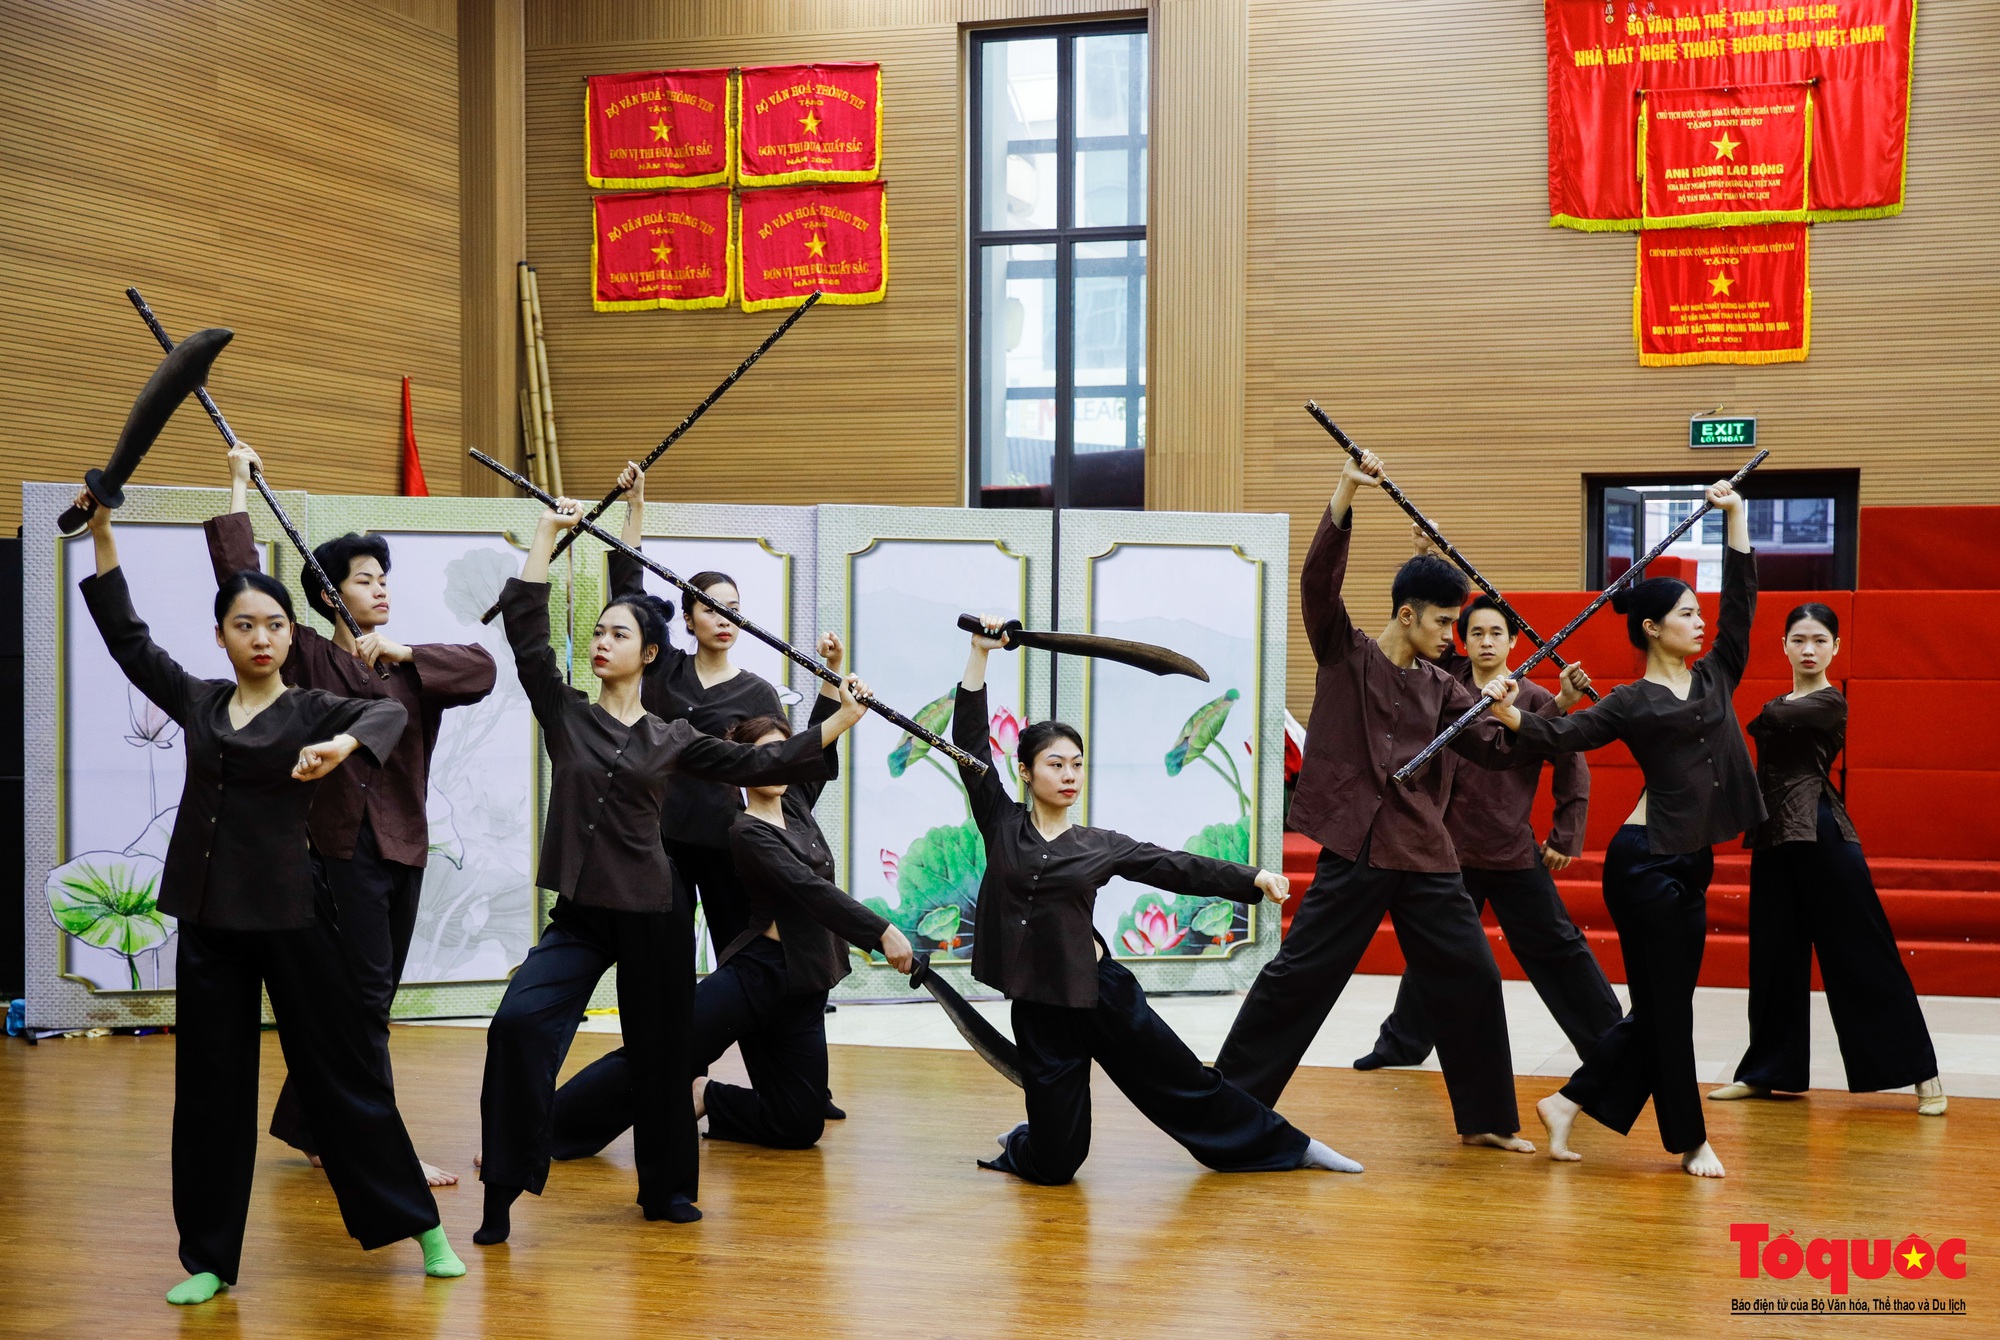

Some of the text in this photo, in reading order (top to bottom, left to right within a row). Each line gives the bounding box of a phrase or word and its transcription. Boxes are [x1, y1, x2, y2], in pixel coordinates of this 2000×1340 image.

[1627, 4, 1837, 38] BỘ VĂN HÓA THỂ THAO VÀ DU LỊCH
[1575, 24, 1885, 67] NHÀ HÁT NGHỆ THUẬT ĐƯƠNG ĐẠI VIỆT NAM
[1687, 116, 1763, 130] TẶNG DANH HIỆU
[1665, 162, 1784, 179] ANH HÙNG LAO ĐỘNG
[1703, 256, 1739, 266] TẶNG
[1697, 335, 1720, 344] NĂM
[1702, 423, 1744, 435] EXIT
[1717, 435, 1744, 443] THOÁT
